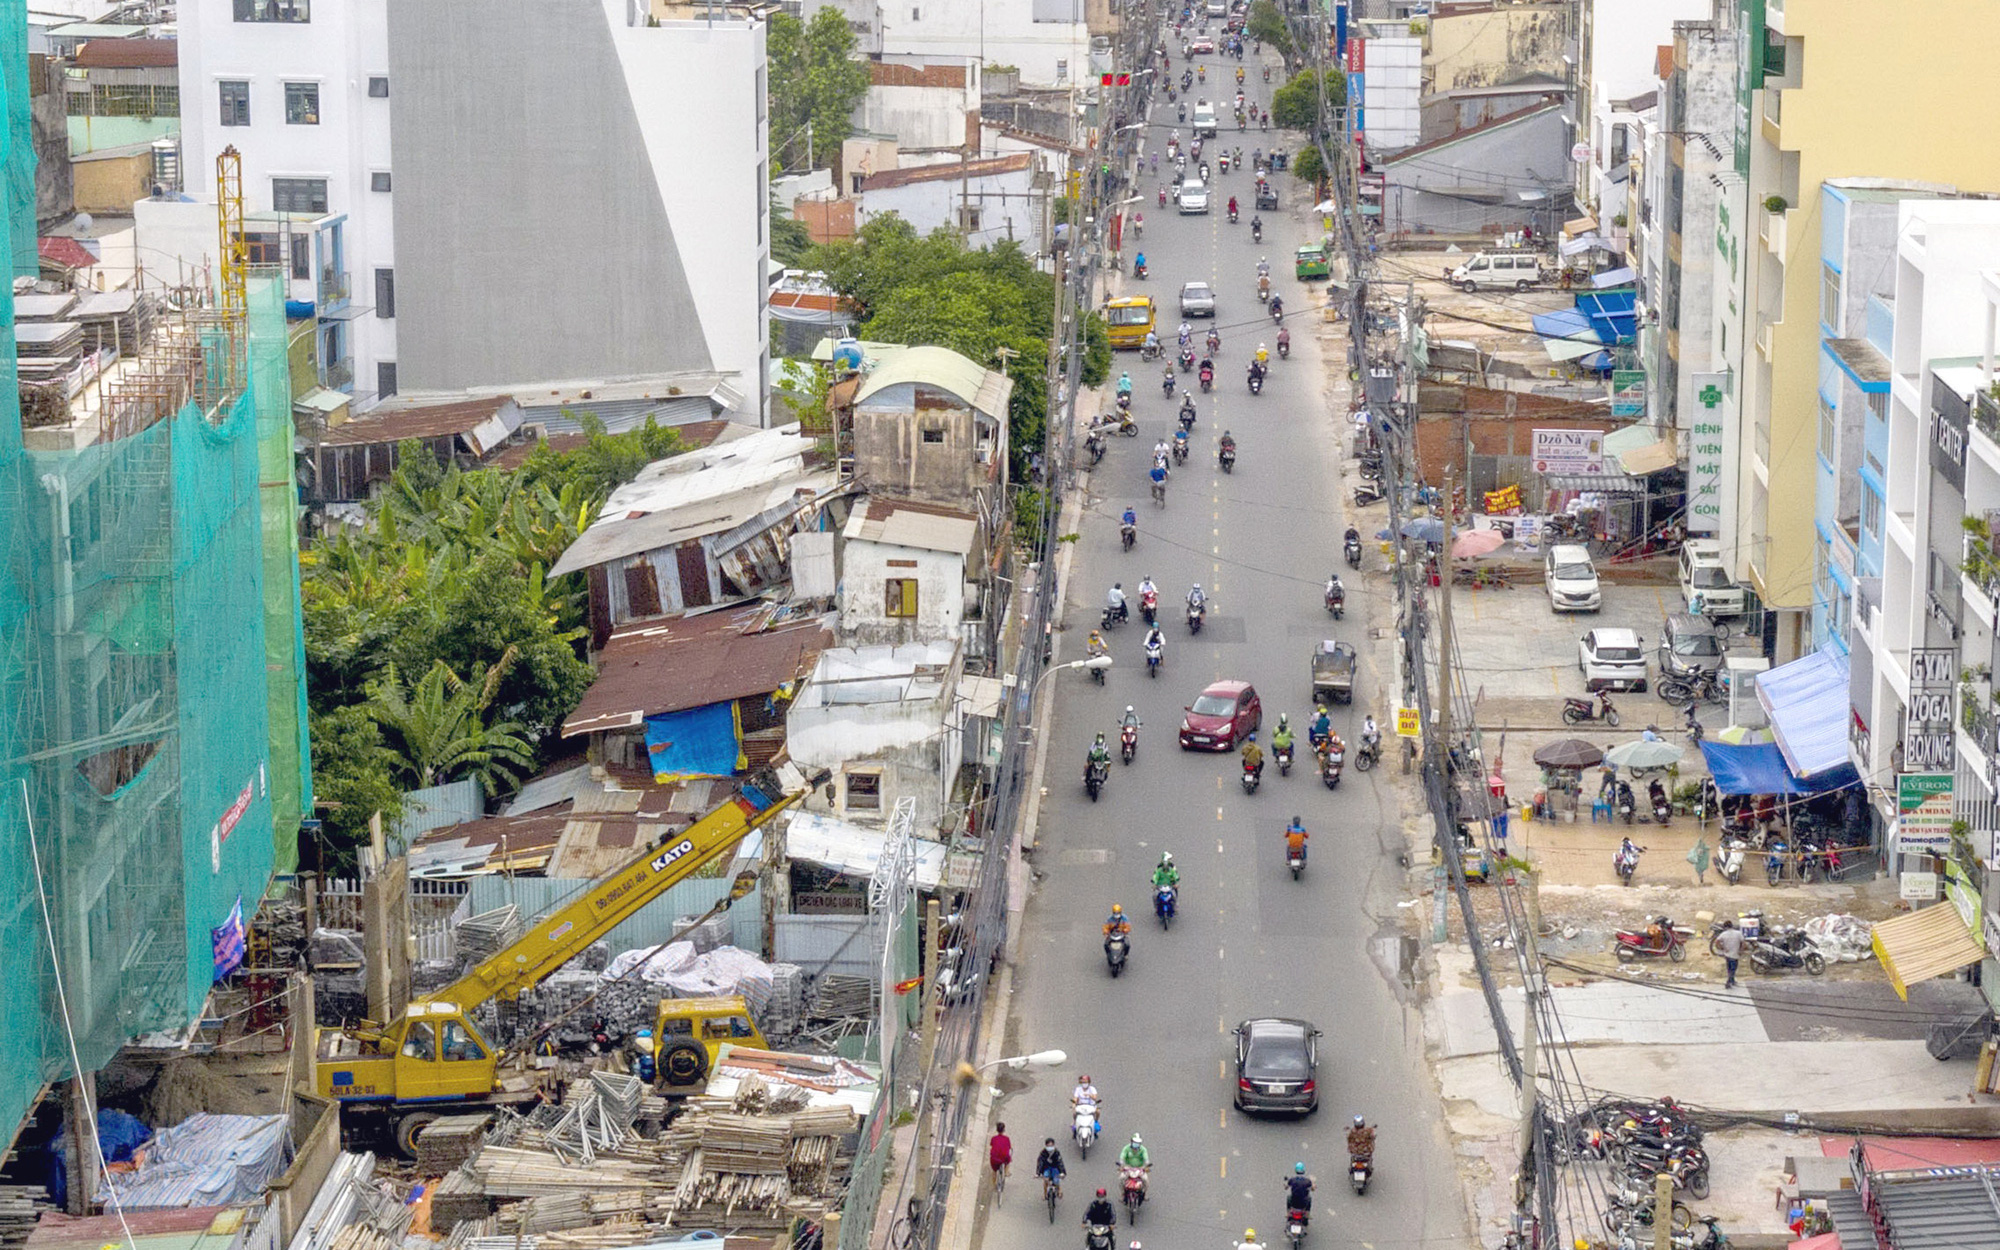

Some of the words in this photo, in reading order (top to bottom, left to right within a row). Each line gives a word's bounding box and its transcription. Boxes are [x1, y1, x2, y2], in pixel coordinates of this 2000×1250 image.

[1696, 445, 1722, 456] VIỆN
[1696, 462, 1720, 475] MẮT
[1694, 503, 1720, 515] GÒN
[1912, 654, 1953, 681] GYM
[1911, 694, 1951, 722] YOGA
[1907, 735, 1950, 762] BOXING
[1902, 781, 1951, 789] EVERON
[651, 840, 693, 872] KATO
